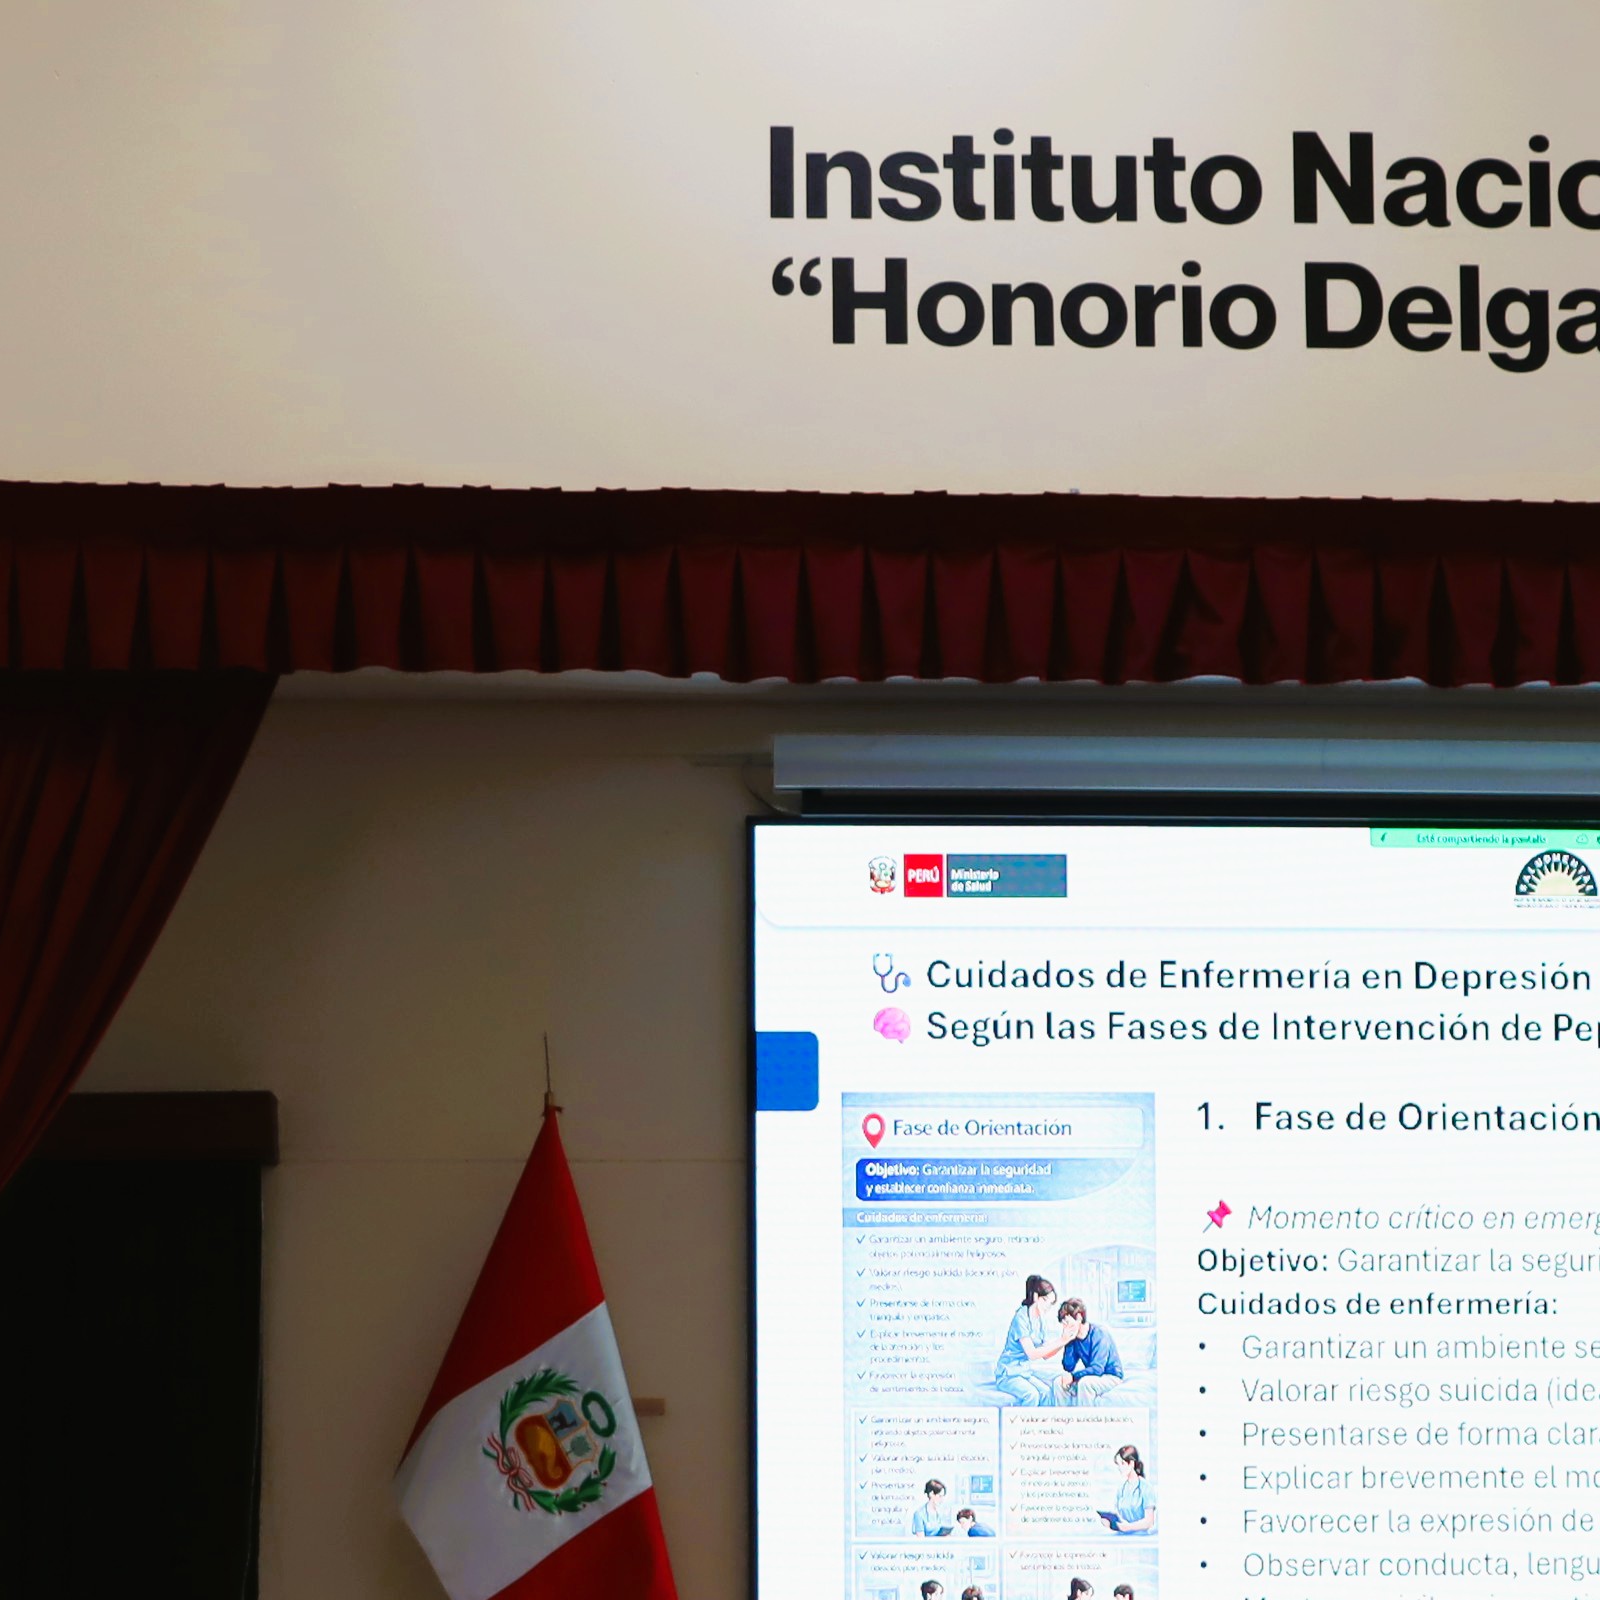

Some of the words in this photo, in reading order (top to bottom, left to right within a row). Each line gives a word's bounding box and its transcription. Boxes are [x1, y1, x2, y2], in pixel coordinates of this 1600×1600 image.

[768, 124, 1264, 227] Instituto
[770, 255, 1278, 352] “Honorio
[907, 865, 941, 884] PERÚ
[950, 881, 964, 893] de
[965, 880, 993, 893] Salud
[925, 958, 1096, 990] Cuidados
[1105, 958, 1148, 989] de
[1159, 958, 1352, 992] Enfermería
[1361, 967, 1404, 991] en
[1414, 959, 1592, 998] Depresión
[926, 1008, 1035, 1048] Según
[1045, 1009, 1097, 1041] las
[1108, 1009, 1209, 1041] Fases
[1218, 1010, 1261, 1041] de
[1272, 1010, 1491, 1042] Intervención
[1500, 1011, 1544, 1042] de
[893, 1119, 933, 1136] Fase
[936, 1119, 960, 1136] de
[964, 1119, 1072, 1136] Orientación
[1196, 1099, 1226, 1131] 1.
[1255, 1099, 1336, 1132] Fase
[1345, 1100, 1388, 1132] de
[864, 1161, 920, 1180] Objetivo:
[1247, 1204, 1380, 1230] Momento
[1388, 1202, 1475, 1230] crítico
[1482, 1210, 1516, 1230] en
[1197, 1246, 1329, 1279] Objetivo:
[1337, 1246, 1482, 1273] Garantizar
[1489, 1247, 1513, 1273] la
[1197, 1289, 1338, 1316] Cuidados
[1345, 1290, 1382, 1316] de
[1389, 1289, 1559, 1316] enfermería:
[1241, 1332, 1387, 1360] Garantizar
[1394, 1339, 1428, 1360] un
[1436, 1332, 1567, 1360] ambiente
[1240, 1377, 1340, 1403] Valorar
[1348, 1376, 1431, 1410] riesgo
[1438, 1376, 1538, 1403] suicida
[1242, 1420, 1408, 1448] Presentarse
[1415, 1420, 1449, 1447] de
[1457, 1420, 1539, 1447] forma
[1243, 1508, 1380, 1535] Favorecer
[1387, 1508, 1411, 1535] la
[1419, 1506, 1553, 1540] expresión
[1561, 1507, 1595, 1533] de
